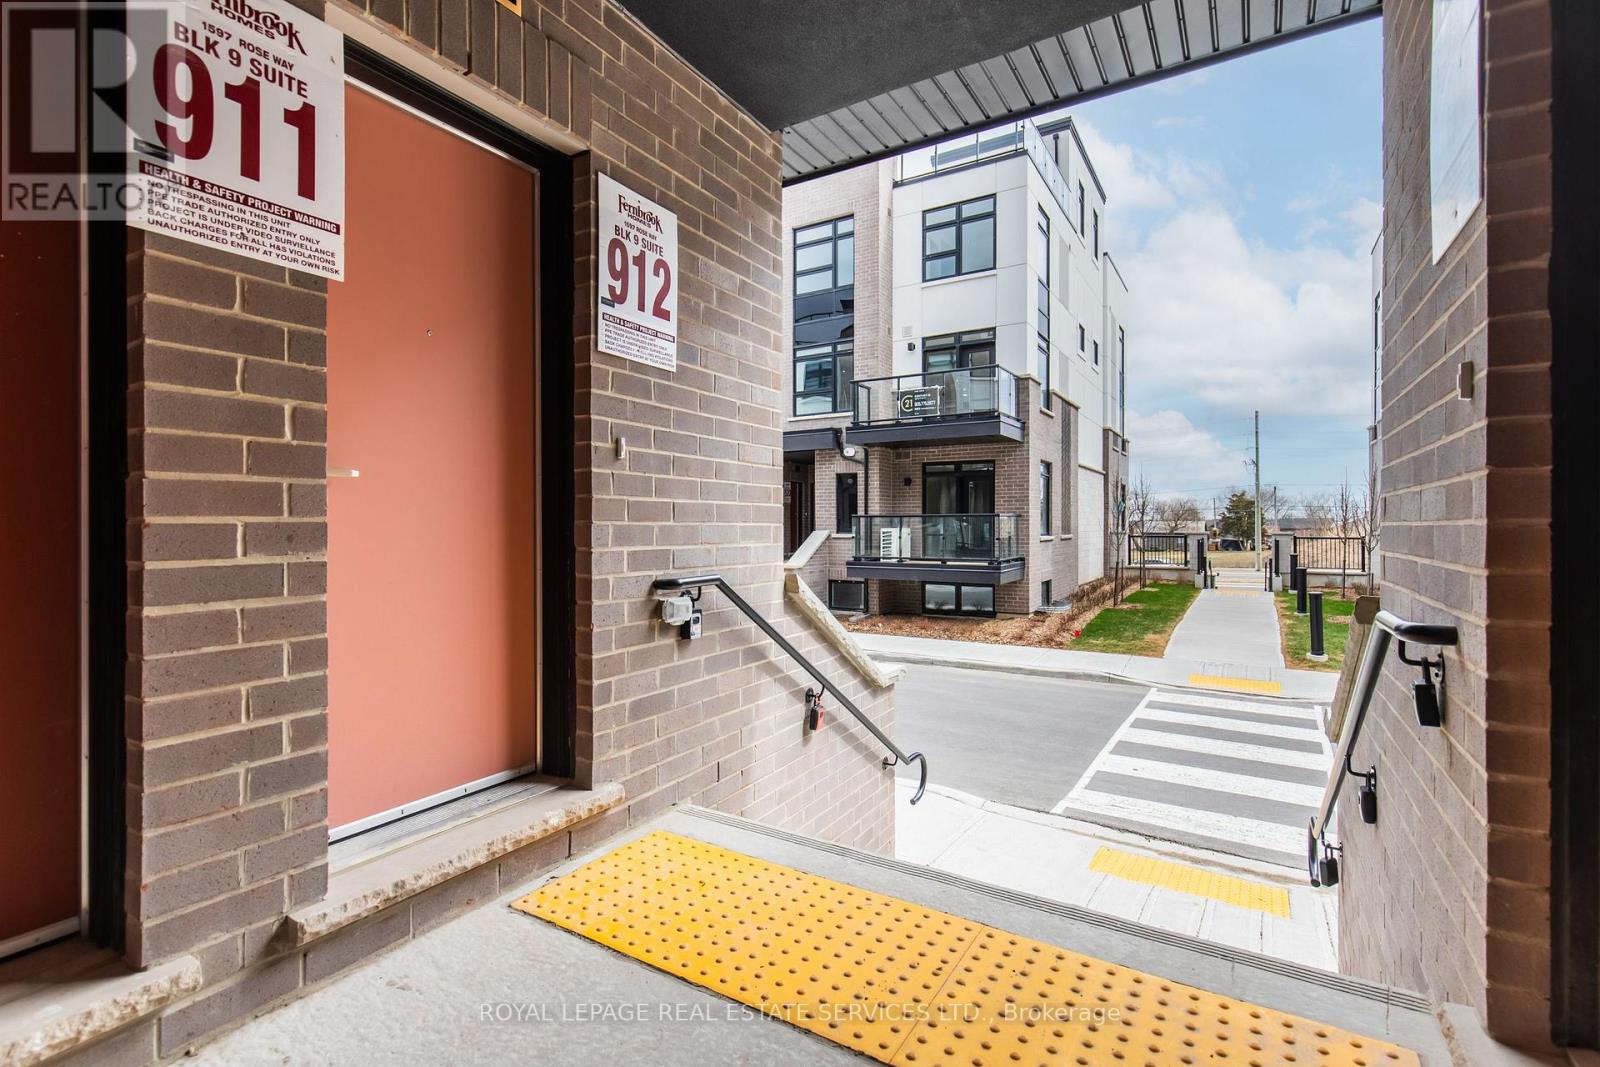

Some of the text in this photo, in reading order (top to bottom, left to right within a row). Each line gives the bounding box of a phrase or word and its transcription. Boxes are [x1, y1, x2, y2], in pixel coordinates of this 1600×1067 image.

[211, 2, 275, 39] HOMES
[174, 21, 308, 99] BLK 9 SUITE
[202, 21, 295, 71] 1597 ROSE WAY
[152, 43, 316, 202] 911
[144, 163, 337, 233] HEALTH & SAFETY PROJECT WARNING
[147, 180, 291, 228] NO TRESPASSING IN THIS UNIT
[147, 199, 196, 218] PROJECT
[210, 217, 243, 231] UNDER
[245, 228, 273, 240] VIDEO
[171, 197, 205, 211] TRADE
[207, 207, 268, 230] AUTHORIZED
[270, 226, 297, 239] ENTRY
[300, 235, 320, 245] ONLY
[618, 194, 663, 234] Fernbrook
[147, 208, 336, 266] BACK CHARGES FOR ALL H&S VIOLATIONS
[147, 218, 340, 275] UNAUTHORIZED ENTRY AT YOUR OWN RISK
[615, 224, 663, 257] BLK 9 SUITE
[607, 237, 671, 322] 912
